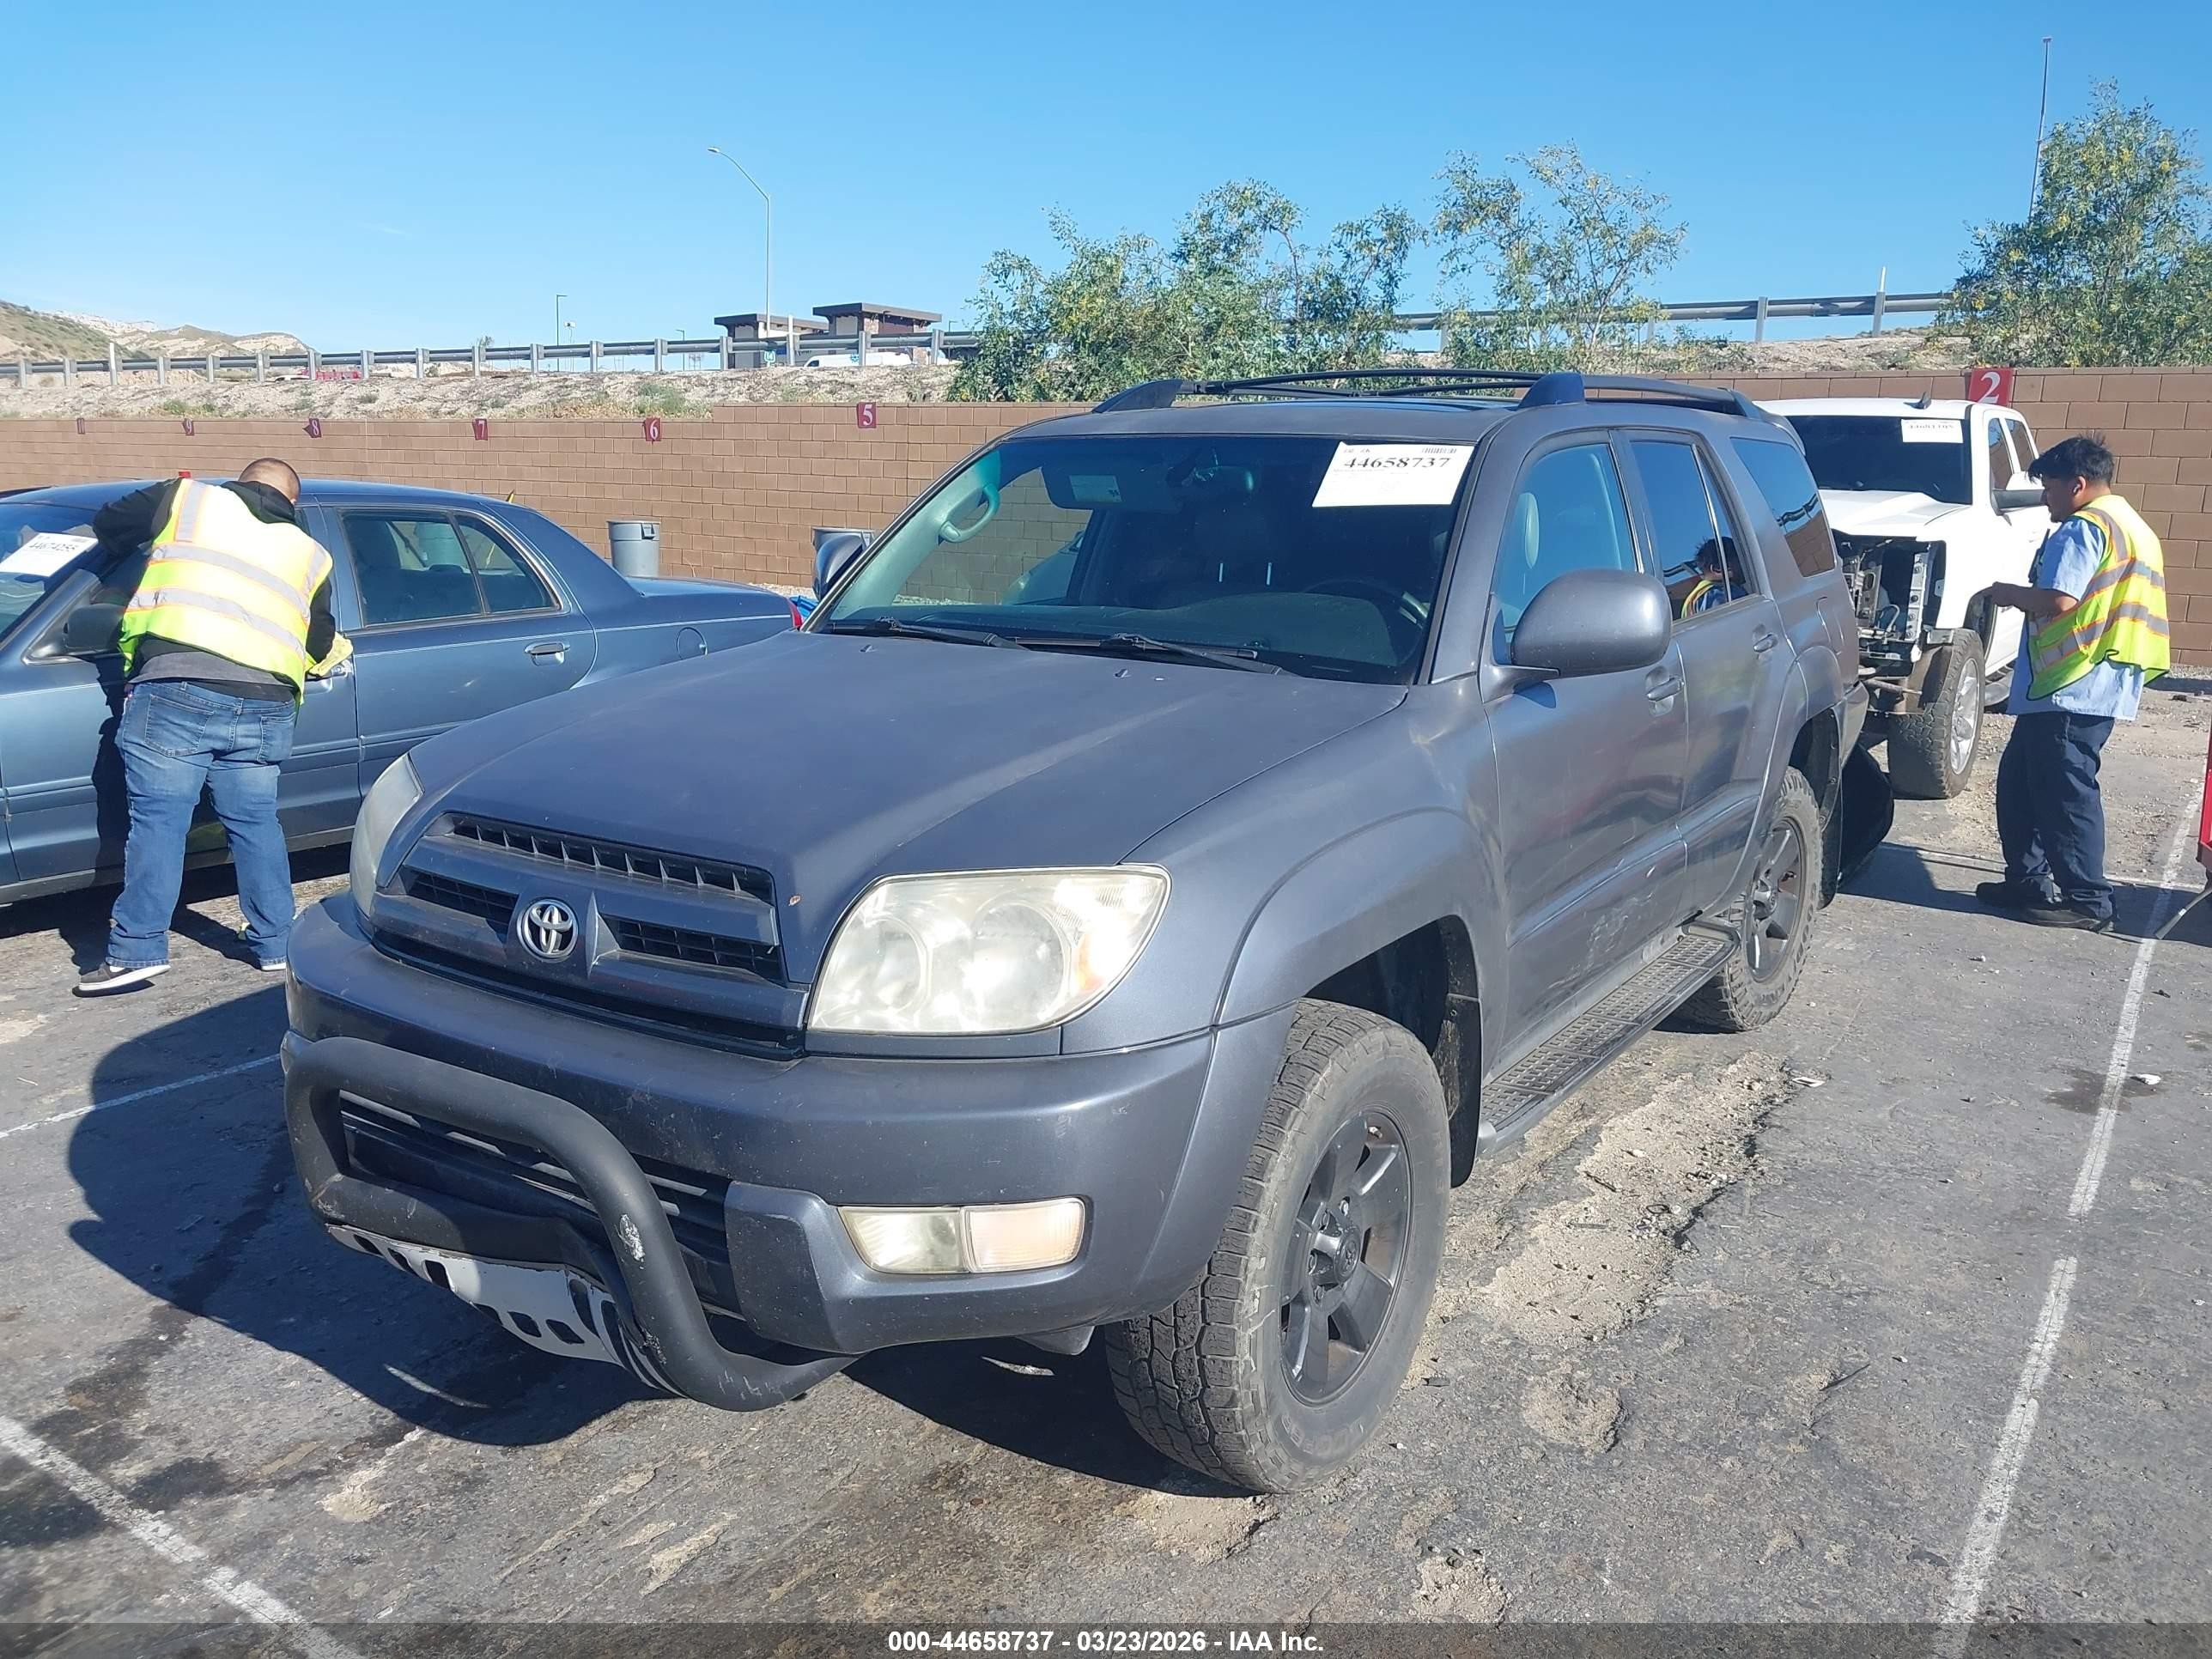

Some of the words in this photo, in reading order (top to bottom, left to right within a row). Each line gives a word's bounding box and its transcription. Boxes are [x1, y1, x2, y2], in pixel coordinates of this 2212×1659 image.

[1978, 371, 2001, 404] 2
[863, 404, 873, 426] 5
[185, 419, 192, 434] 9
[312, 419, 319, 436] 8
[478, 420, 485, 439] 7
[650, 419, 659, 441] 6
[1344, 457, 1451, 468] 44658737
